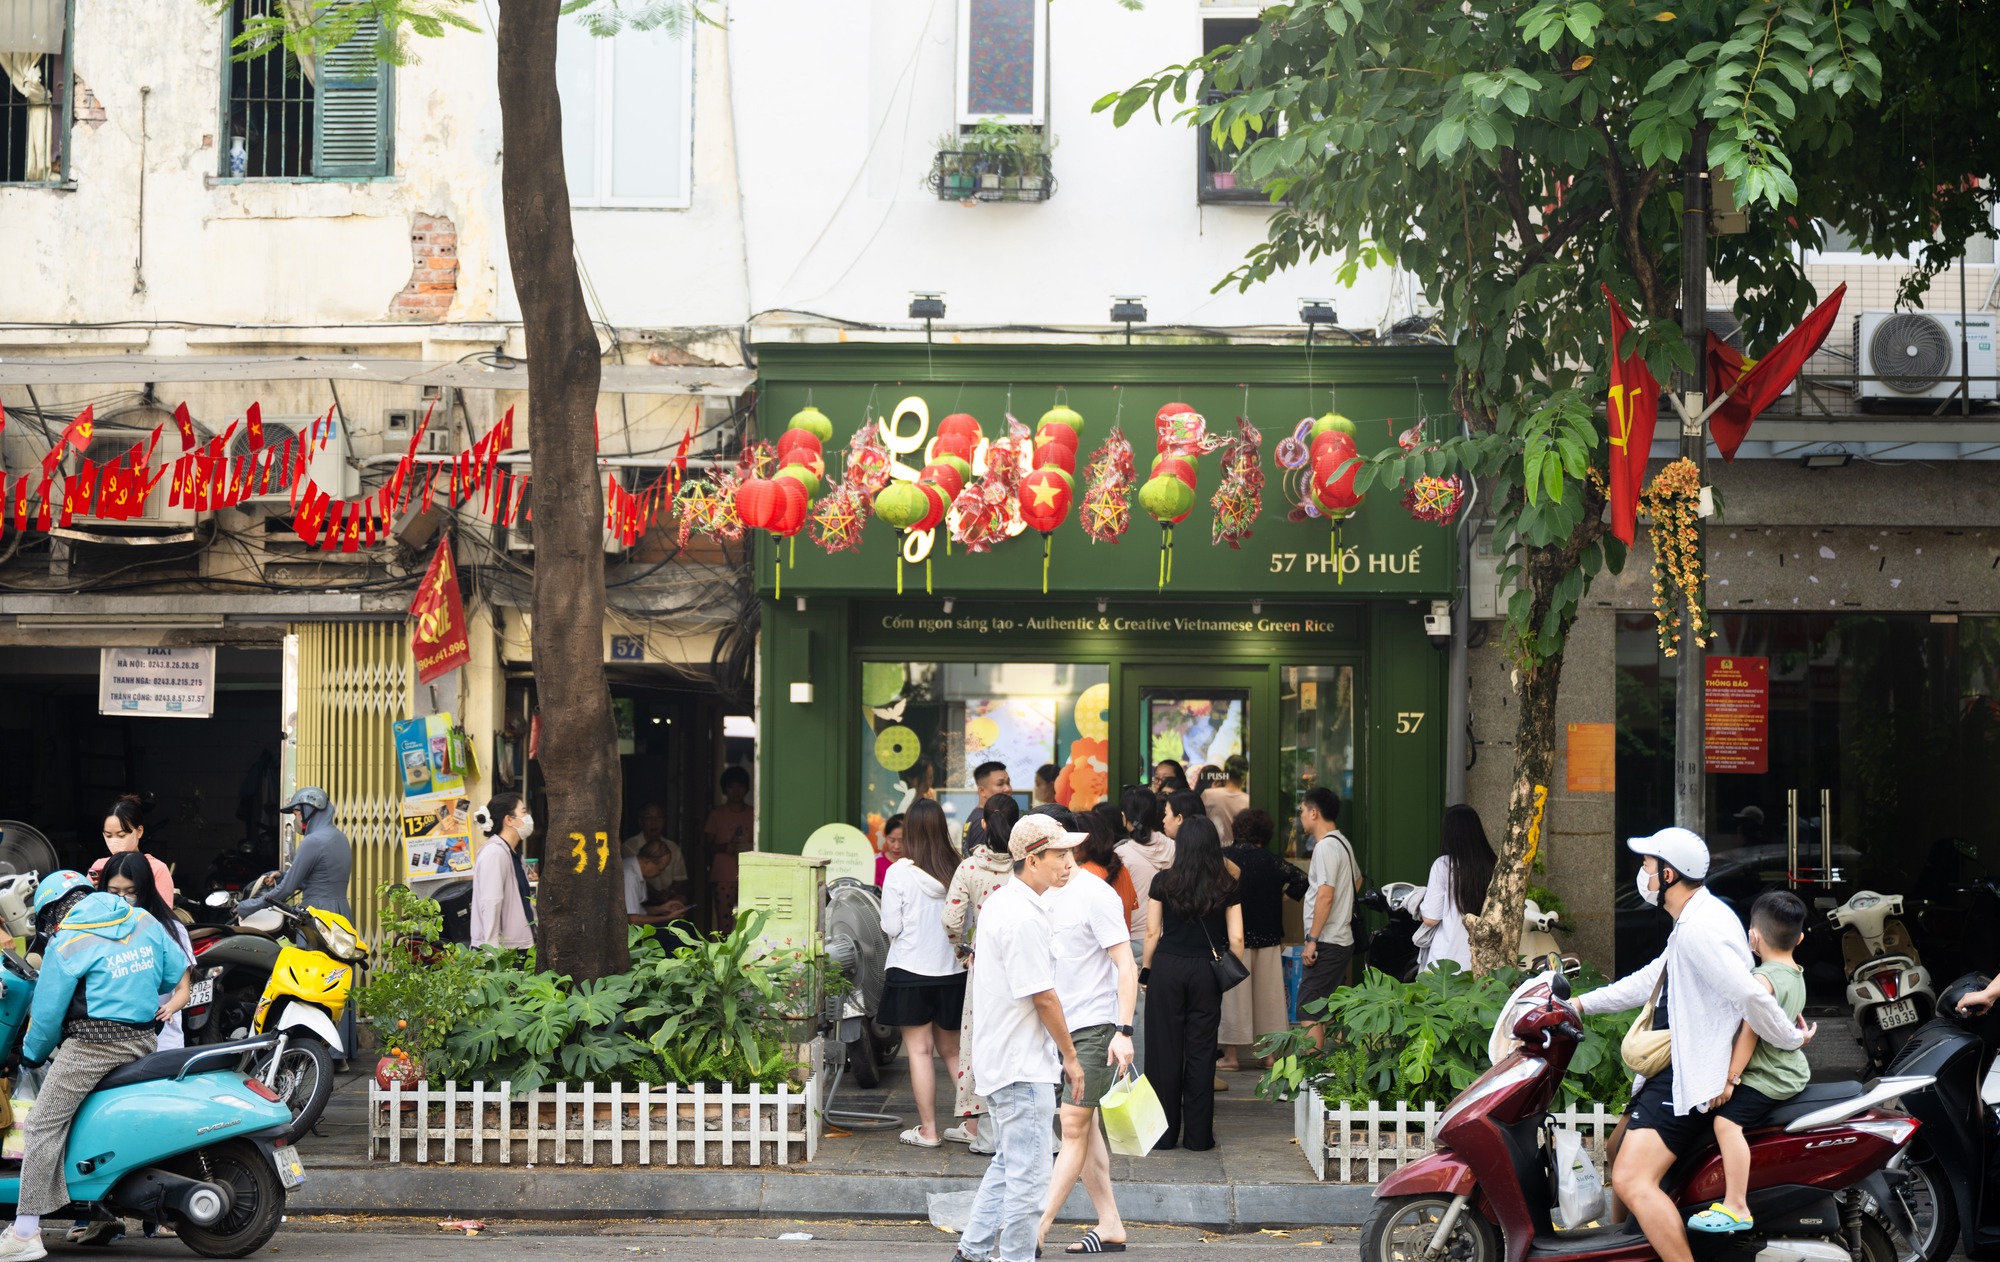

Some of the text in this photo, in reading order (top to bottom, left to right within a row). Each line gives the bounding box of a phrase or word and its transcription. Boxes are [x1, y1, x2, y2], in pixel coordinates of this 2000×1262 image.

[1269, 545, 1423, 573] 57 PHỐ HUẾ
[882, 614, 915, 629] Cốm
[918, 618, 953, 632] ngon
[956, 616, 988, 633] sáng
[992, 617, 1014, 633] tạo
[1026, 616, 1094, 630] Authentic
[1098, 617, 1110, 630] &
[1113, 617, 1172, 631] Creative
[1174, 617, 1253, 631] Vietnamese
[1257, 618, 1300, 632] Green
[1305, 619, 1335, 632] Rice
[617, 639, 639, 657] 57
[117, 659, 128, 668] HÀ
[113, 676, 136, 684] THANH
[1732, 679, 1749, 687] BÁO
[1396, 711, 1425, 734] 57
[1207, 772, 1230, 780] PUSH
[106, 945, 154, 968] XANH SM
[111, 957, 154, 979] xin chào!
[1882, 1010, 1916, 1028] 599.35
[1805, 1136, 1858, 1149] LEAD
